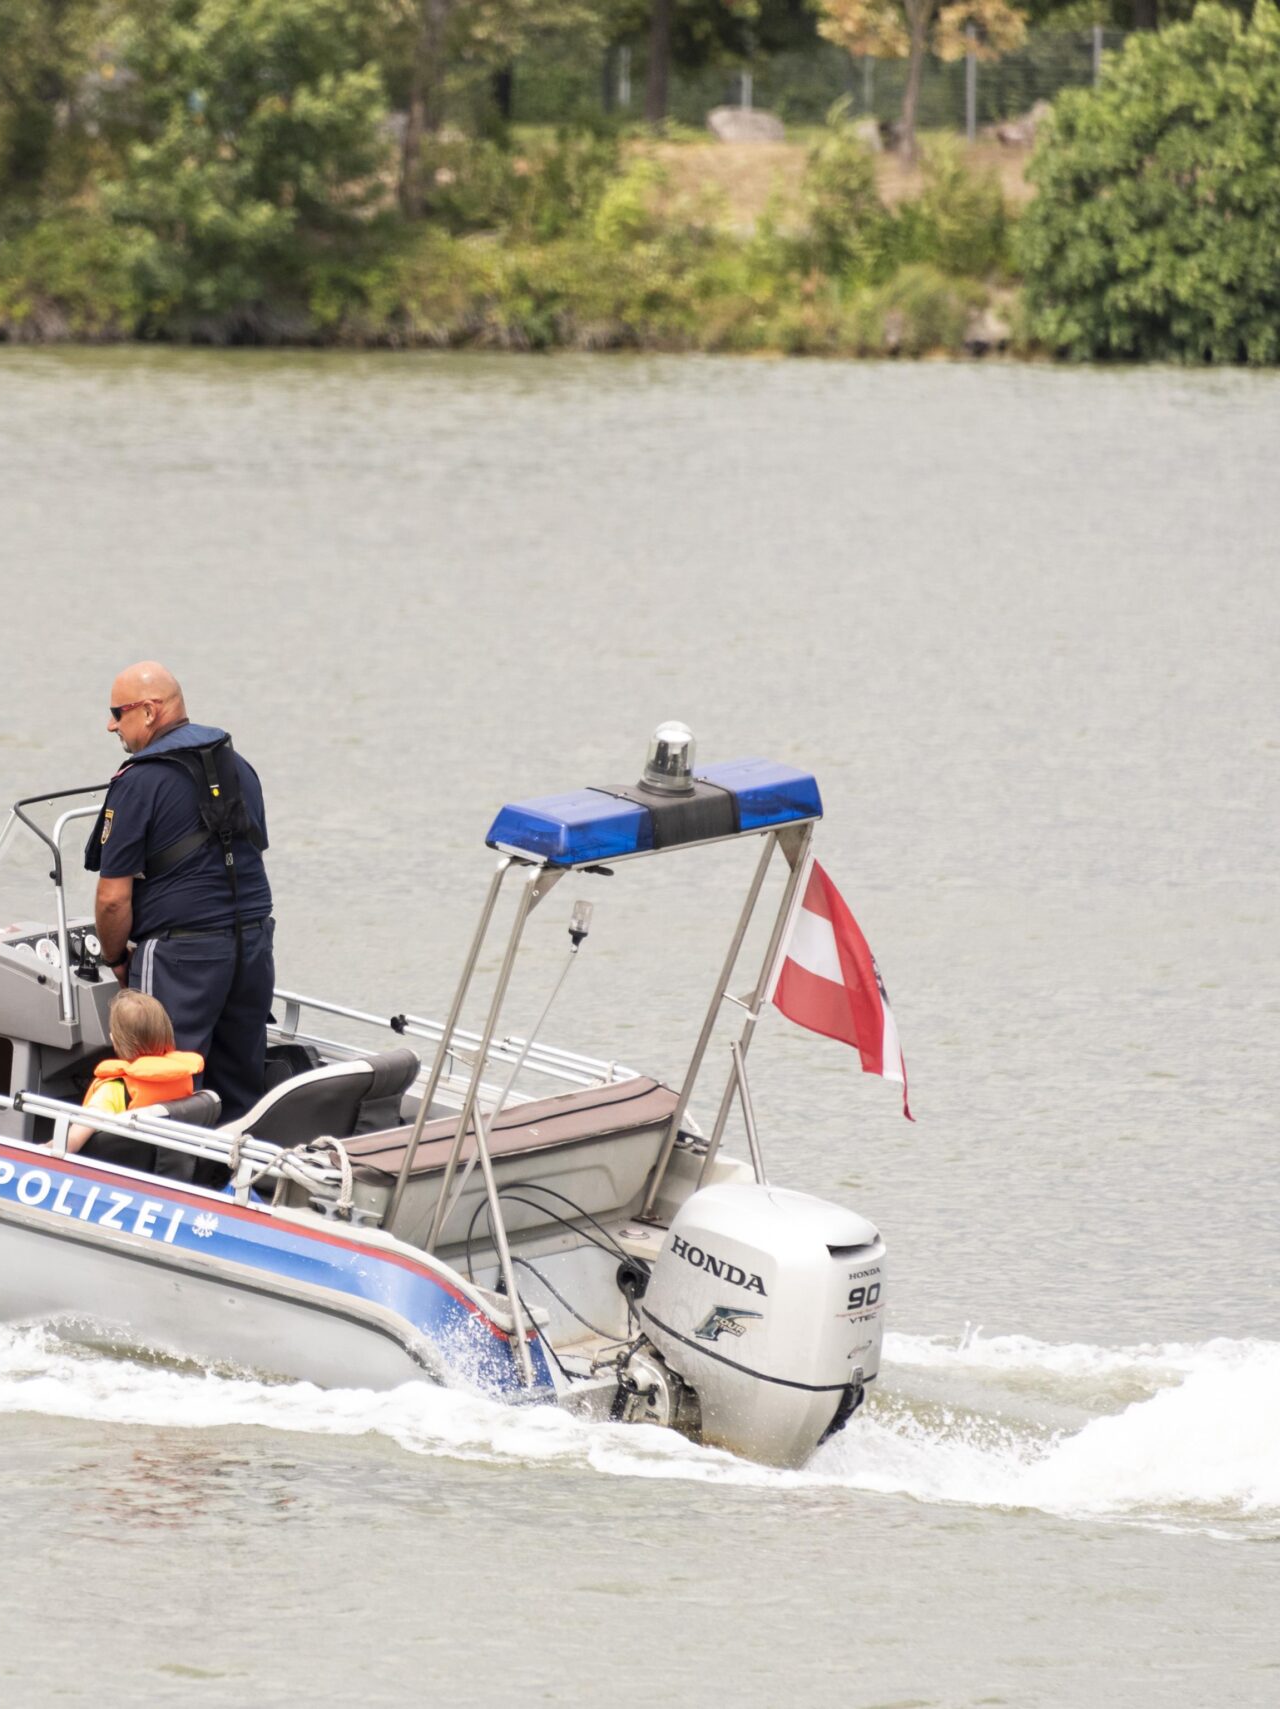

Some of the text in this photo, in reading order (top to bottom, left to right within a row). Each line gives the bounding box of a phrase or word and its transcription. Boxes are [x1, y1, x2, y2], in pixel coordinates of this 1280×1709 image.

[670, 1234, 768, 1297] HONDA
[848, 1267, 881, 1281] HONDA
[847, 1282, 881, 1310] 90
[849, 1311, 878, 1324] VTEC
